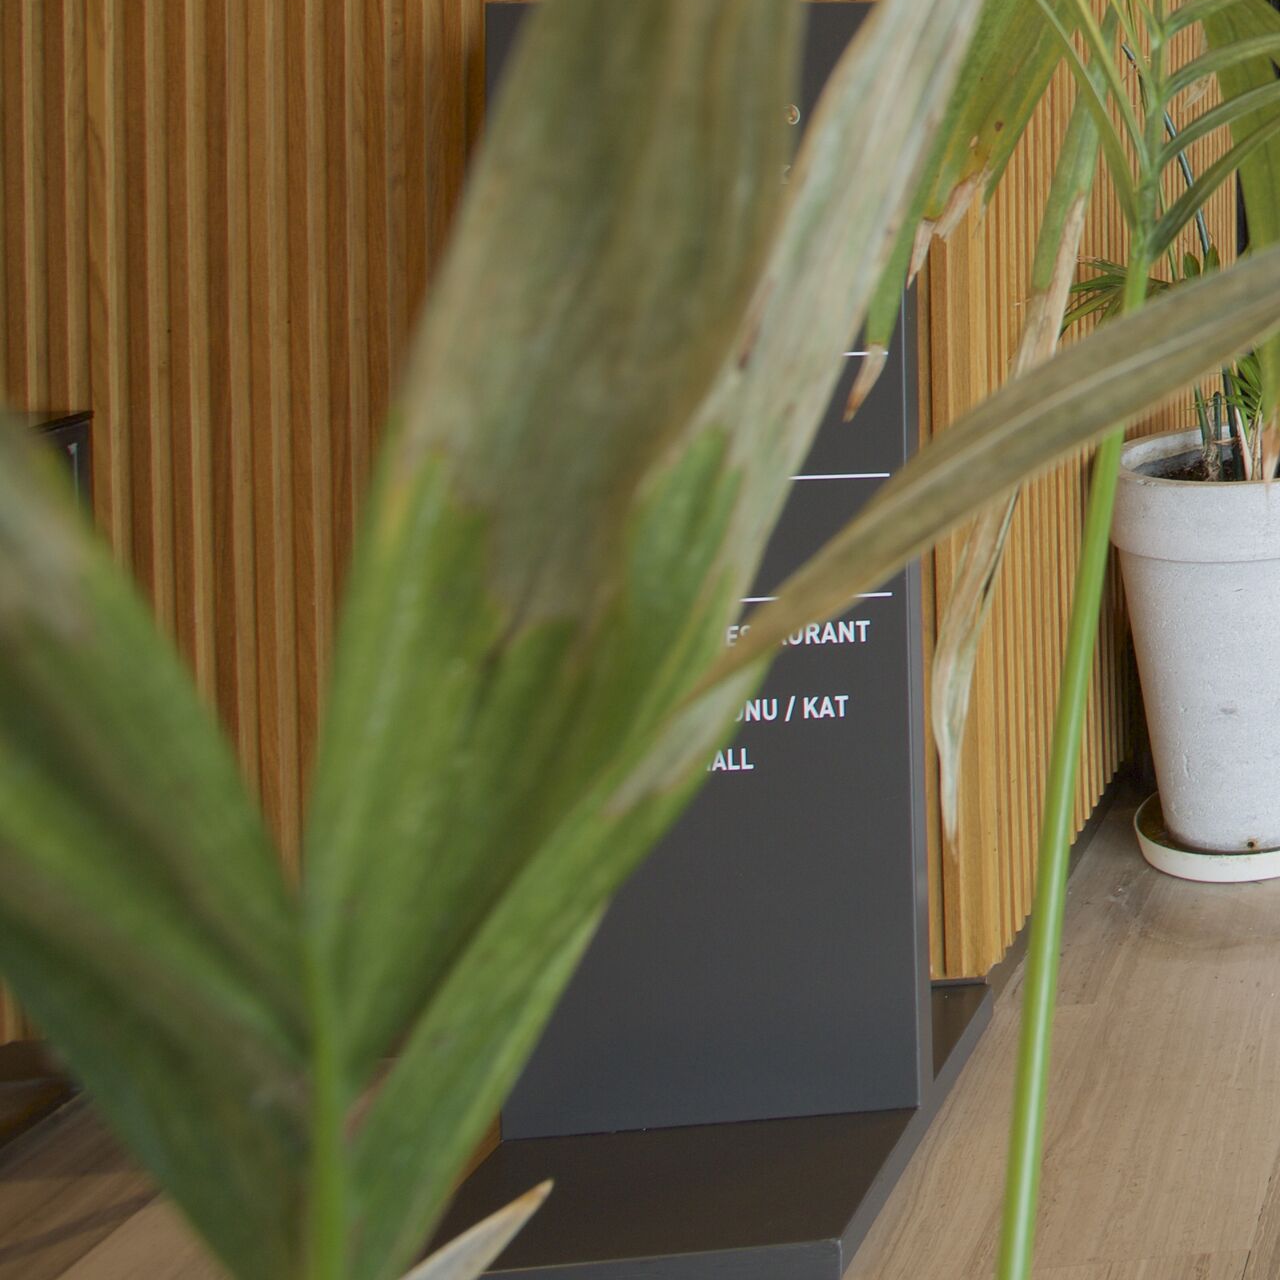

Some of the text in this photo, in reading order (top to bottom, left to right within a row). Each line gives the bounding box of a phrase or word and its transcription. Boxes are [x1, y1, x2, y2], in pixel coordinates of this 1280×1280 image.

[784, 696, 796, 722] /
[803, 695, 849, 719] KAT
[706, 748, 754, 771] ALL
